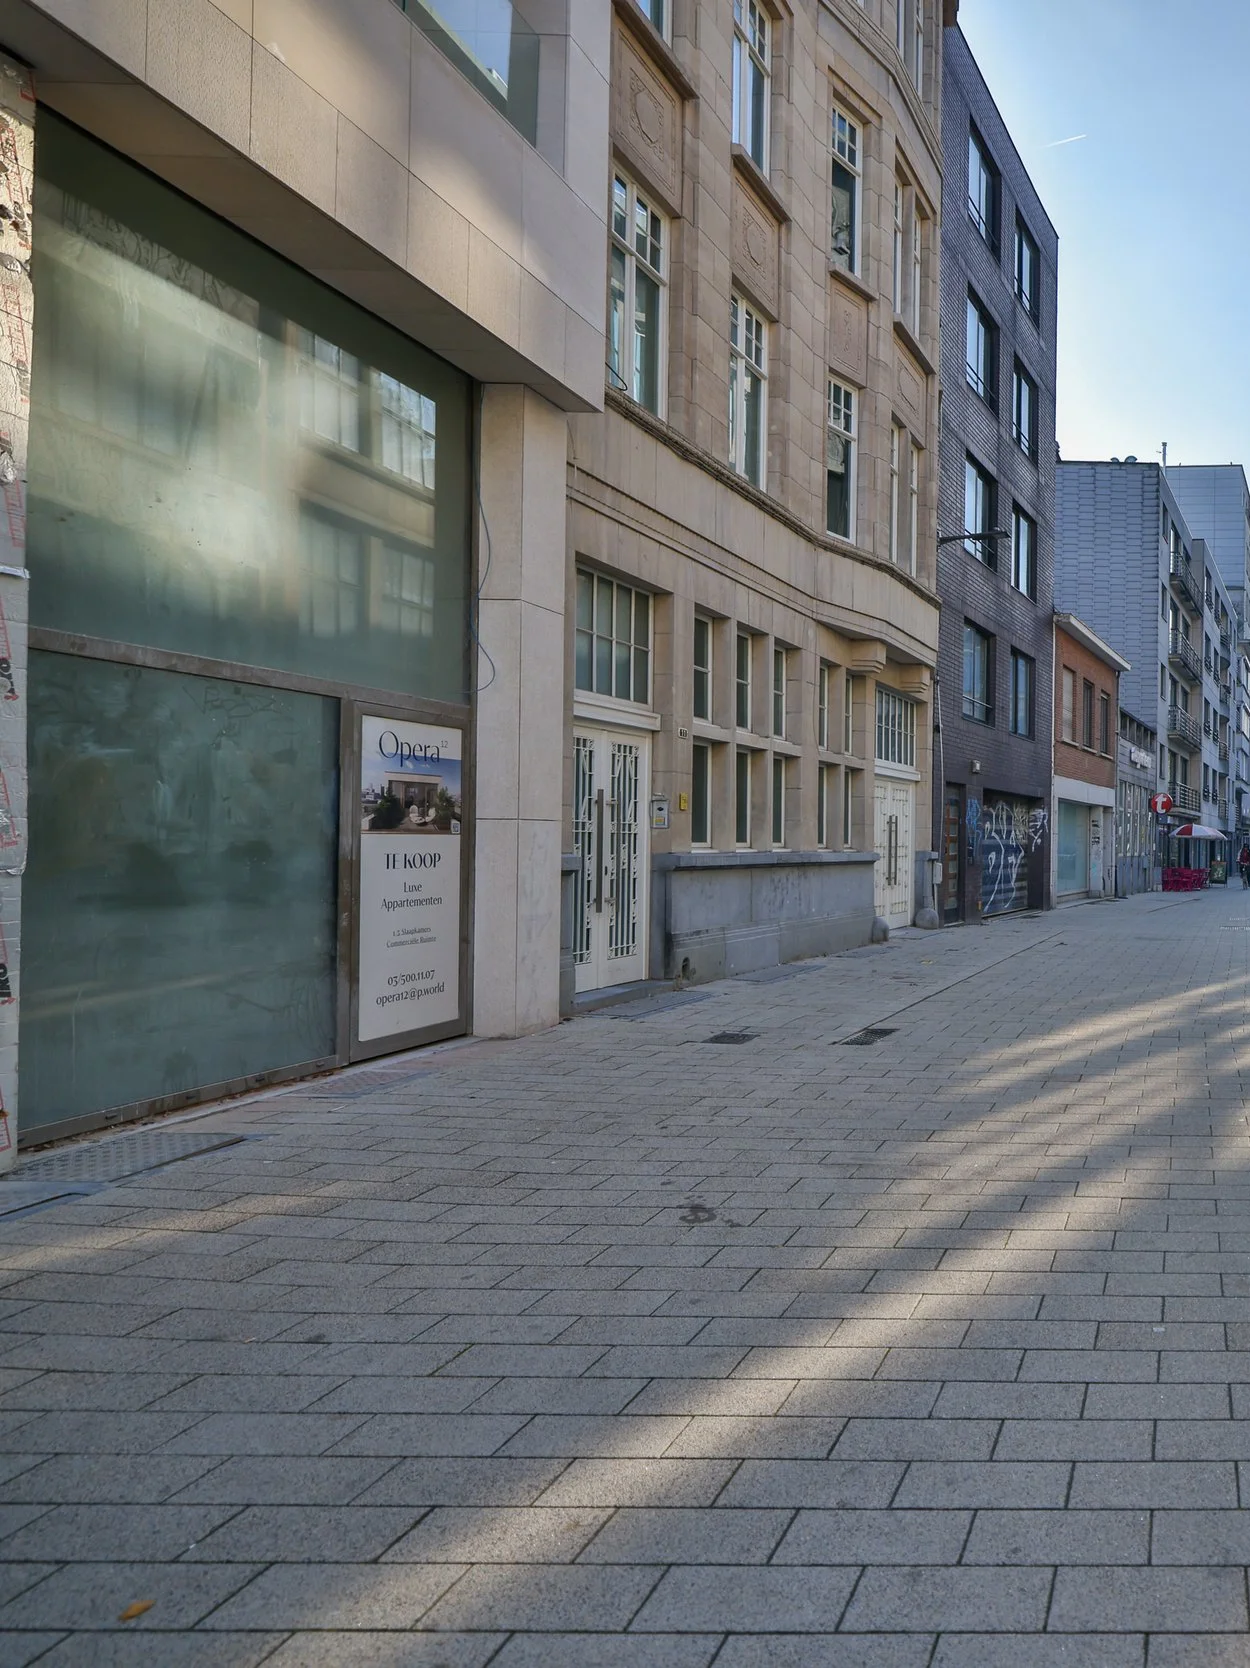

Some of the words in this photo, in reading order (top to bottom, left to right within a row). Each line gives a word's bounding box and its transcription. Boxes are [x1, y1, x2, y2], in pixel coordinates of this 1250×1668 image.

[379, 731, 440, 768] Opera
[441, 740, 448, 748] 12
[384, 853, 400, 870] TE
[404, 852, 441, 869] KOOP
[404, 882, 422, 893] Luxe
[381, 896, 443, 912] Appartementen
[387, 969, 435, 987] 03/500.11.07
[375, 981, 445, 1007] opera12@p.world
